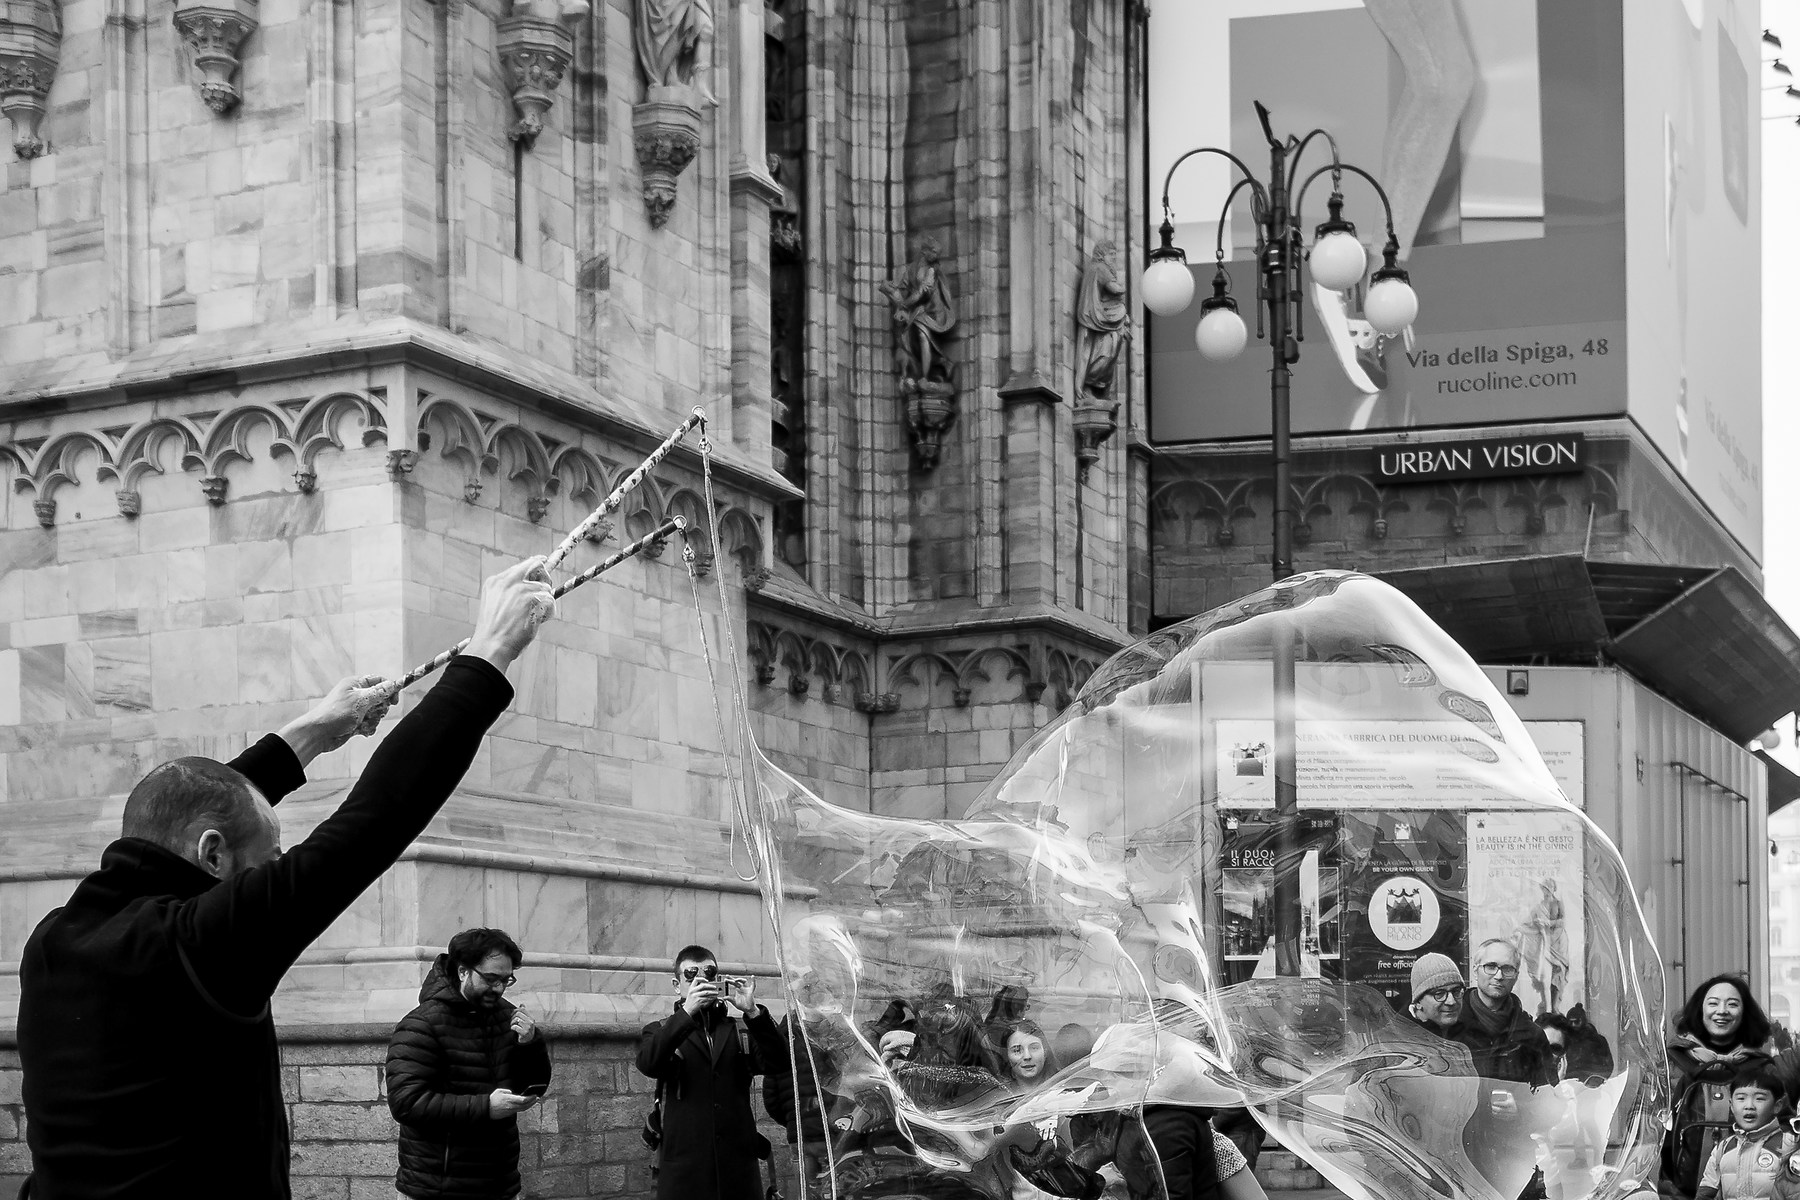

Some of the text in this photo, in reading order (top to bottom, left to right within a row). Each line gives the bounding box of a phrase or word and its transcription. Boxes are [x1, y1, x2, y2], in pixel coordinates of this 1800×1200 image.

[1406, 338, 1609, 368] Via della Spiga, 48
[1437, 371, 1577, 393] rucoline.com
[1380, 441, 1578, 476] URBAN VISION
[1389, 733, 1405, 743] DEL
[1408, 734, 1448, 743] DUOMO
[1548, 835, 1574, 843] GESTO
[1475, 843, 1504, 851] BEAUTY
[1231, 850, 1240, 859] IL
[1231, 857, 1240, 867] SI
[1387, 926, 1422, 934] DUOMO
[1387, 933, 1422, 941] MILANO
[1377, 960, 1392, 970] free
